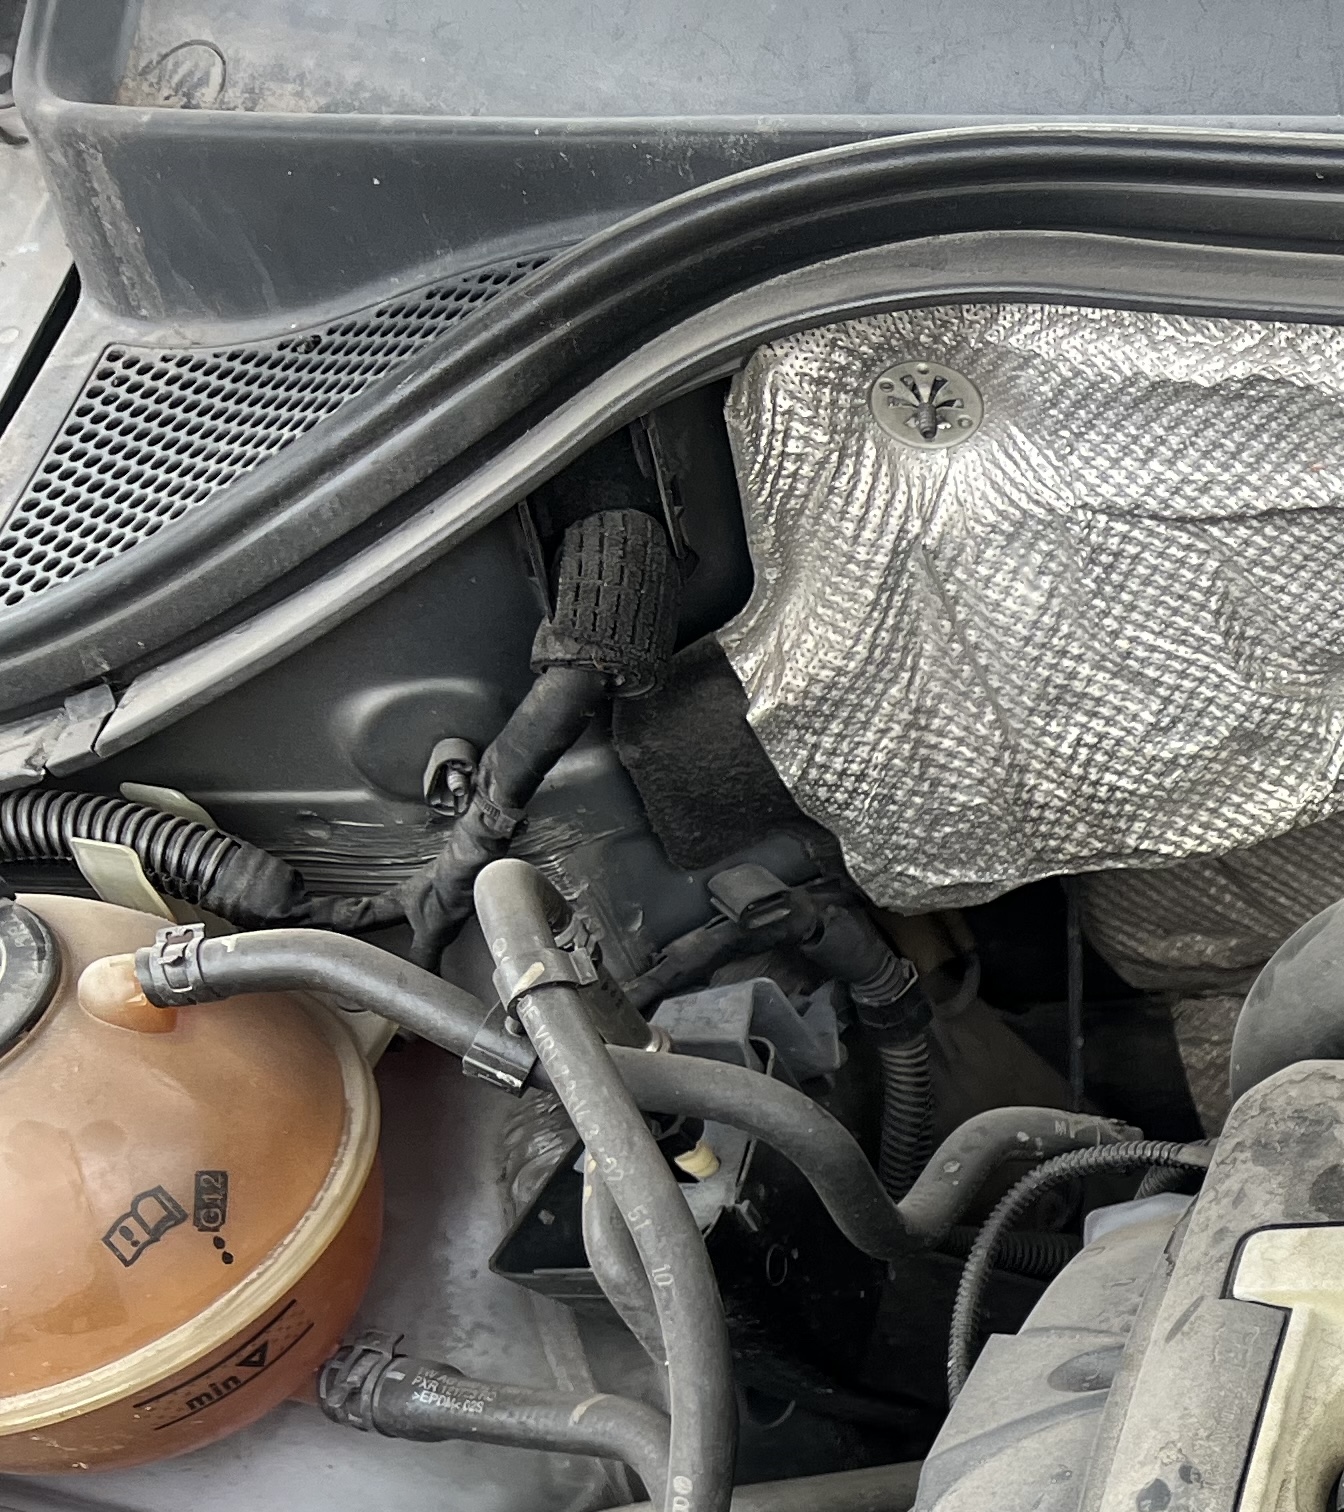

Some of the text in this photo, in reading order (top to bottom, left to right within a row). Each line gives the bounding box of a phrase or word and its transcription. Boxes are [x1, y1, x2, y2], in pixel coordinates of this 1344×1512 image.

[200, 1174, 224, 1228] G12
[652, 1263, 675, 1288] 10
[185, 1374, 242, 1411] min
